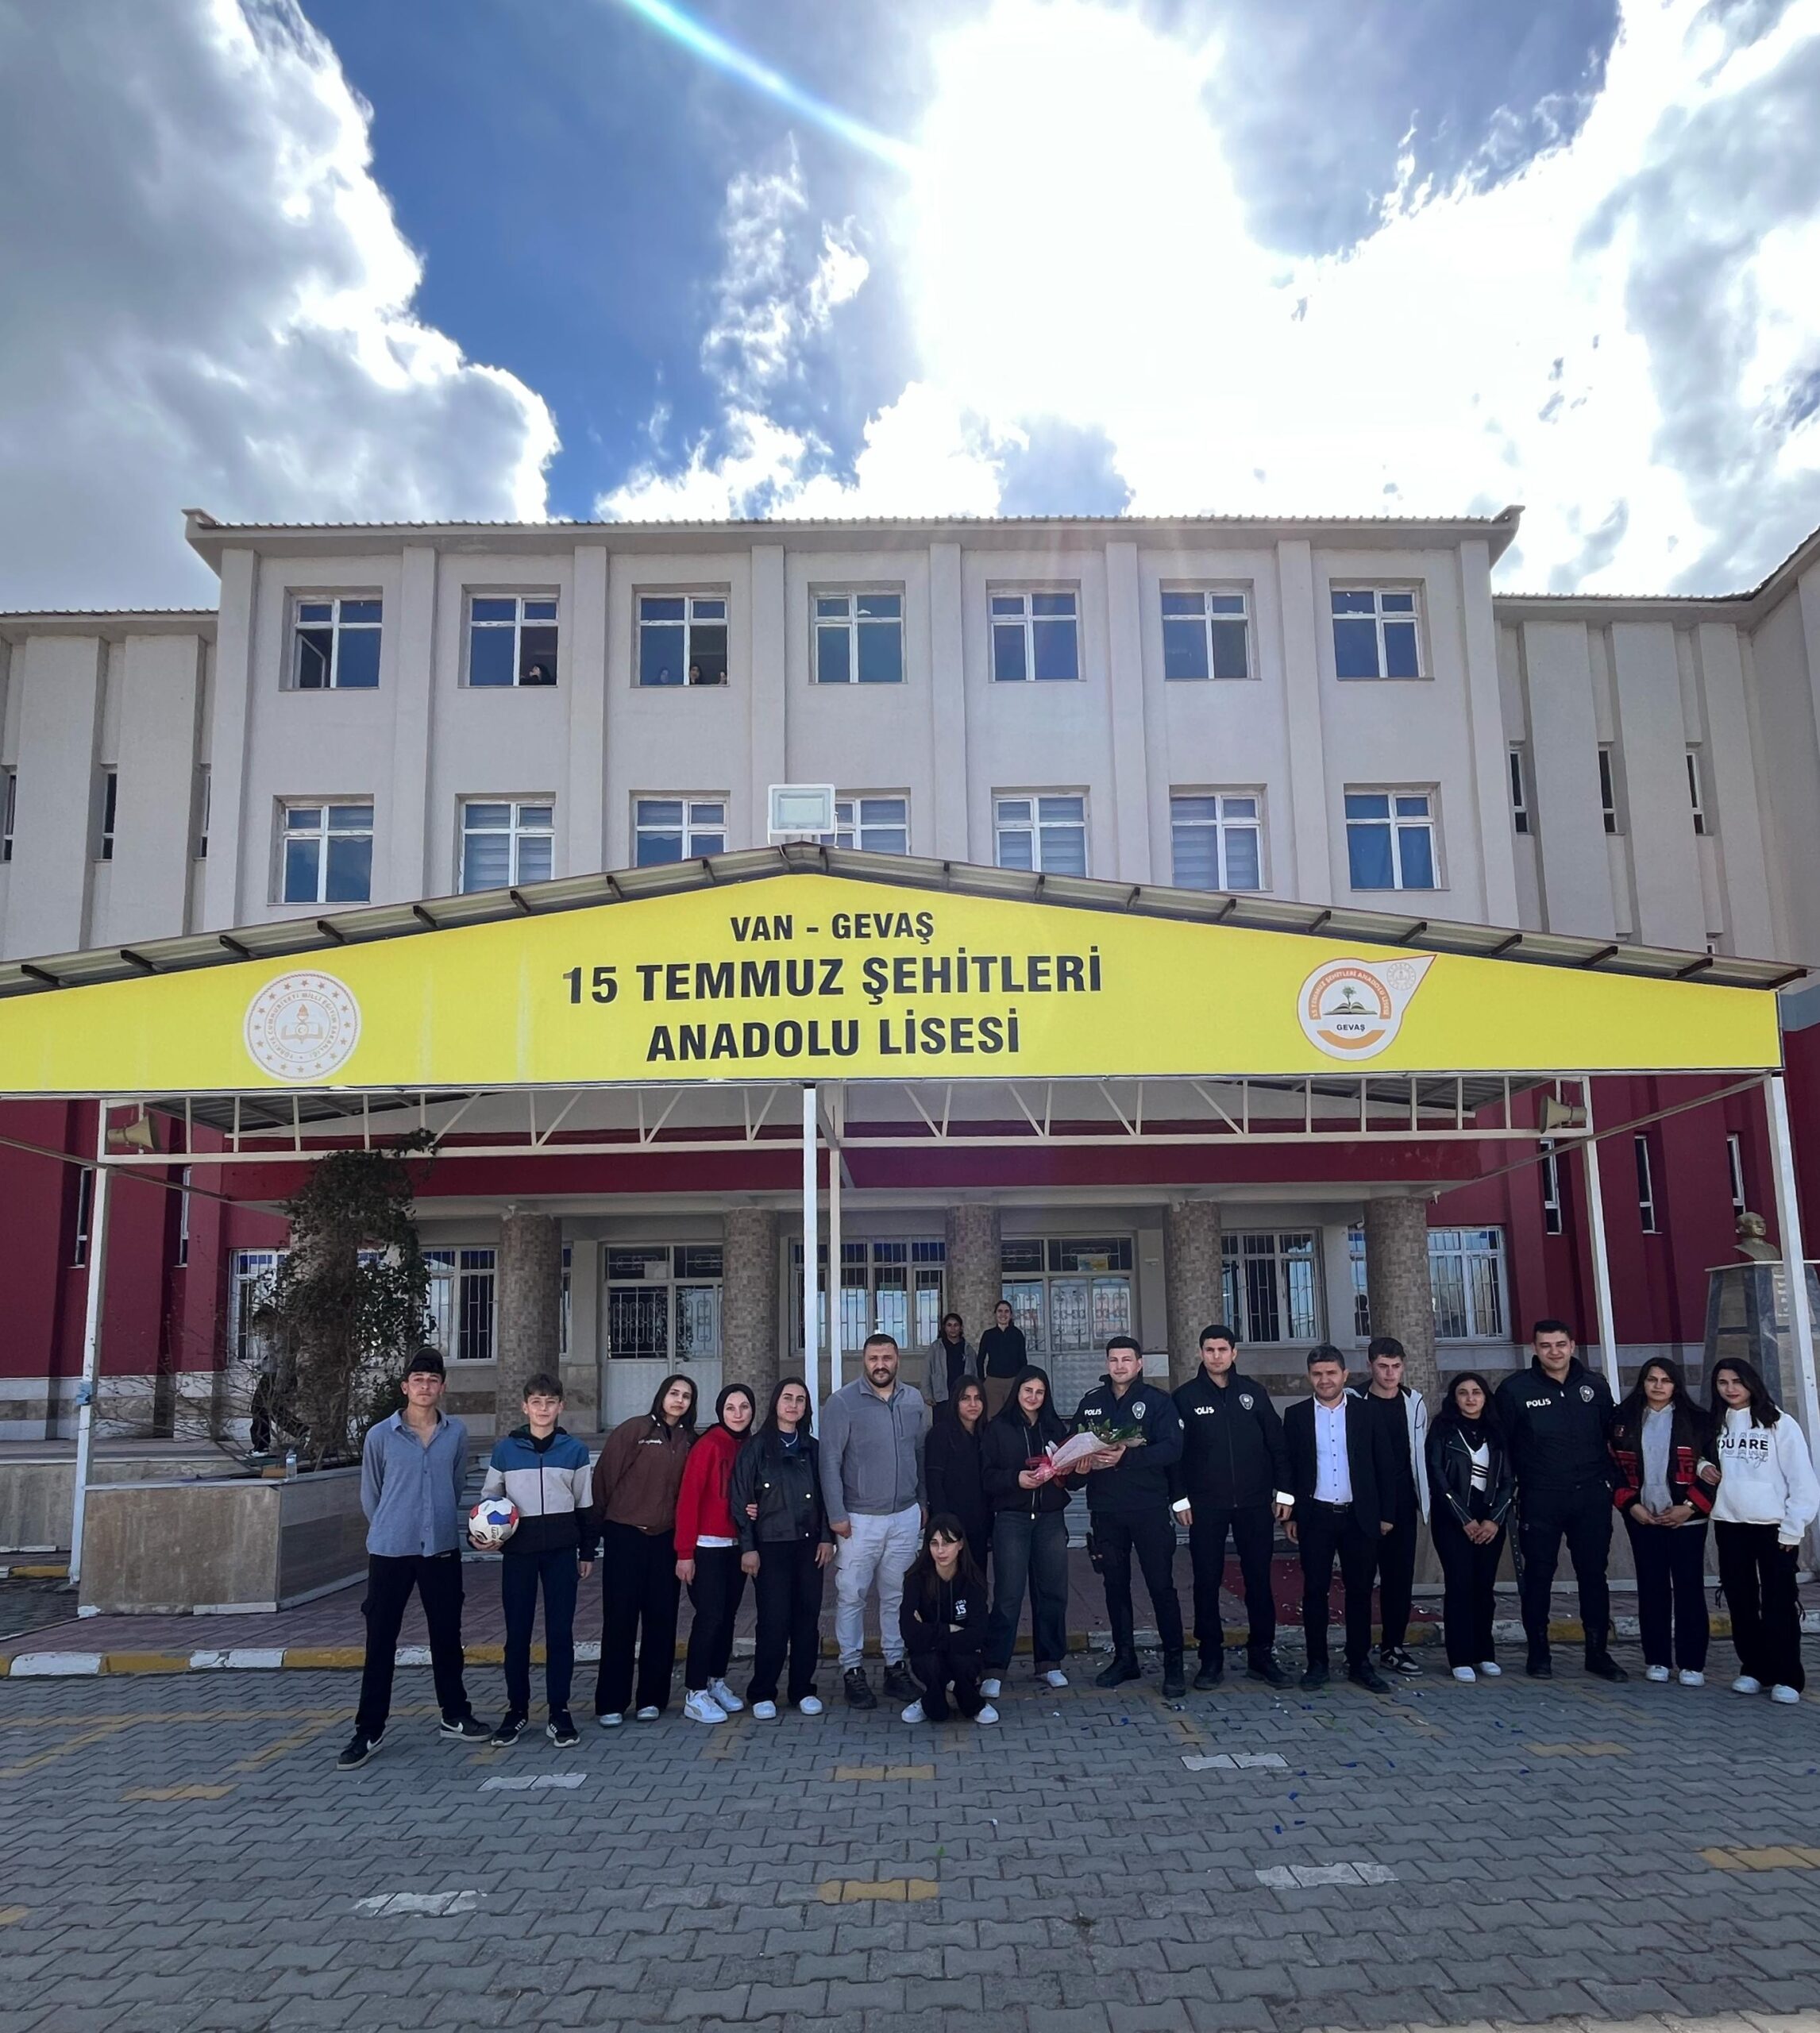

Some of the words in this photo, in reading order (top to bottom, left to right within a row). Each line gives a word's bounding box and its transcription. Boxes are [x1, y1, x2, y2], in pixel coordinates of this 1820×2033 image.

[730, 914, 792, 942] VAN
[831, 912, 934, 945] GEVAŞ
[562, 966, 618, 1004] 15
[636, 959, 844, 1001] TEMMUZ
[862, 945, 1101, 1005] ŞEHİTLERİ
[646, 1020, 858, 1062] ANADOLU
[879, 1008, 1019, 1055] LİSESİ
[1336, 1024, 1365, 1032] GEVAŞ
[1717, 1438, 1734, 1449] OU
[1738, 1438, 1768, 1451] ARE
[955, 1604, 966, 1614] 15
